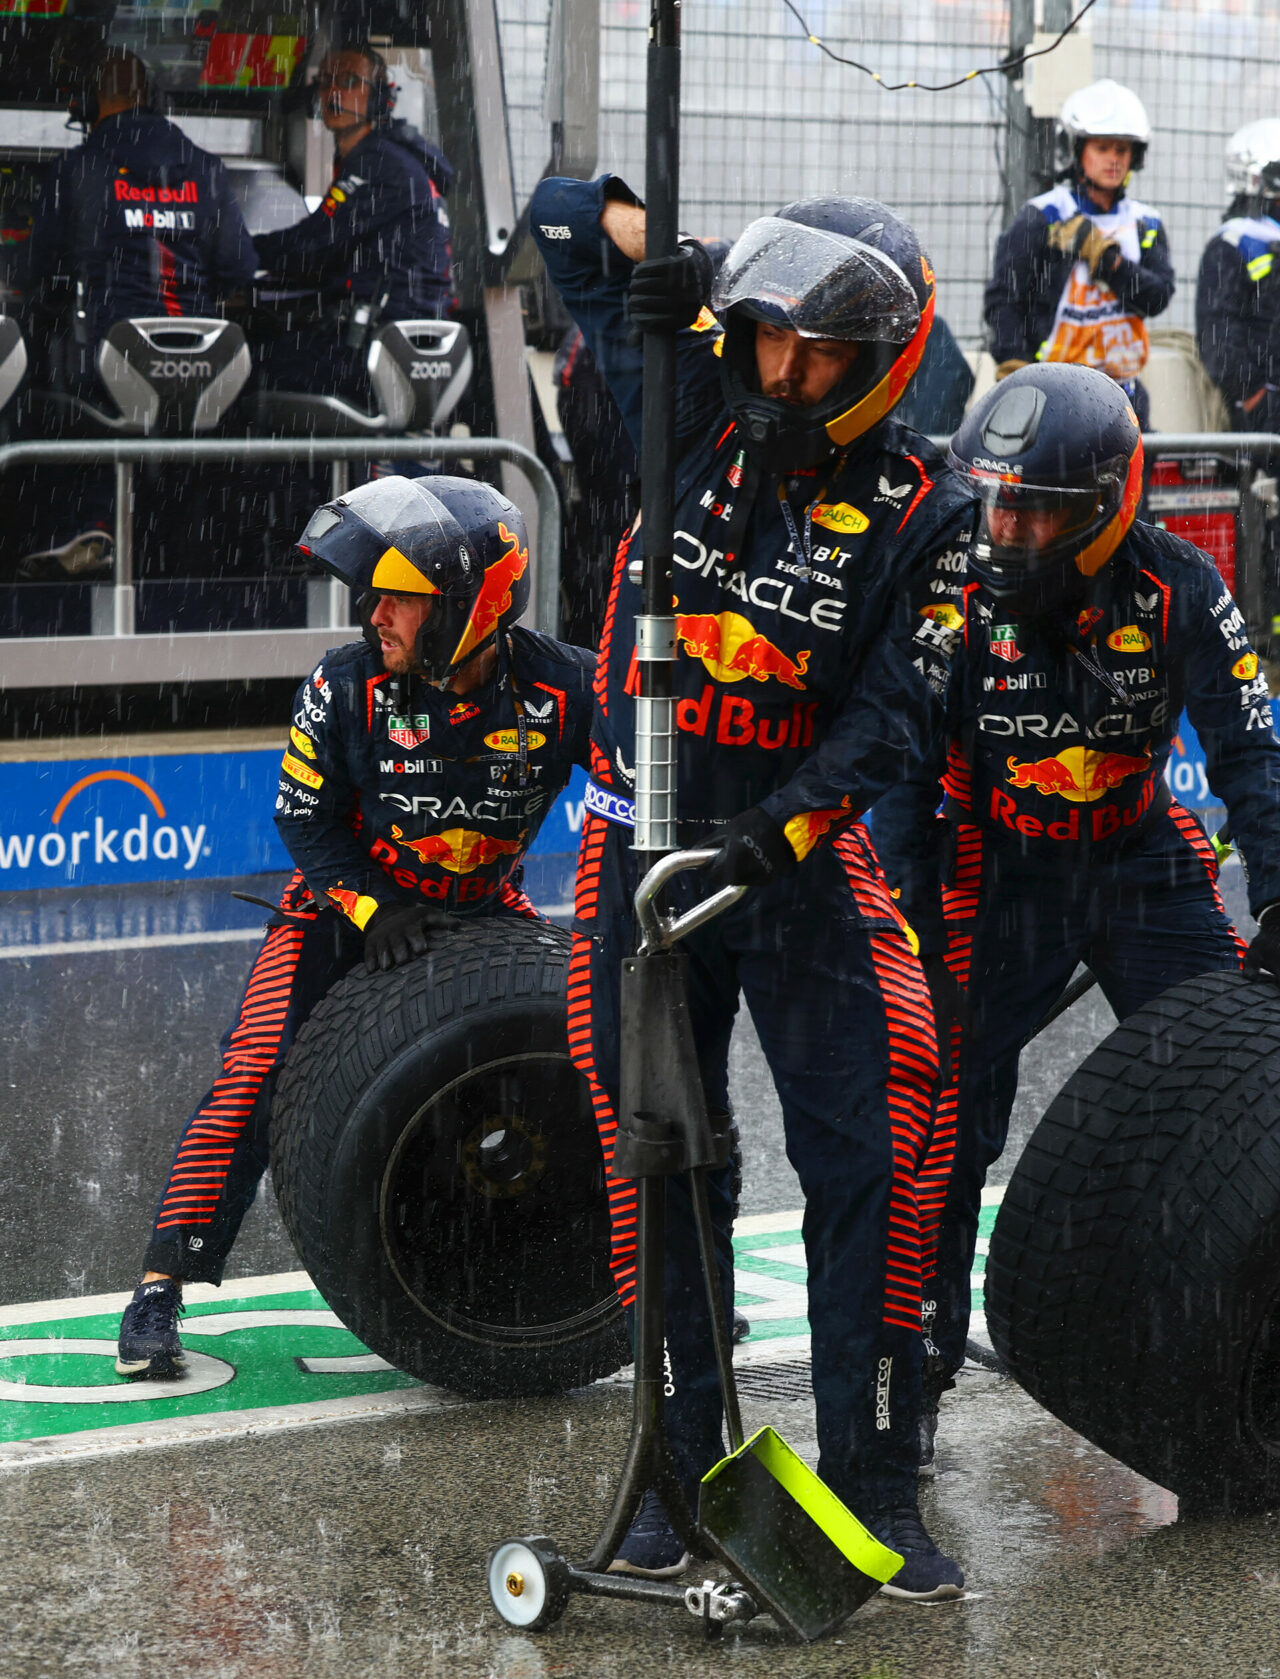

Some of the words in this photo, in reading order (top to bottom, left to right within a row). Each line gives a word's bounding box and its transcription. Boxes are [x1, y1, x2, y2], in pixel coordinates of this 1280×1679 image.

[114, 179, 157, 202] Red
[124, 208, 176, 229] Mobil
[150, 360, 212, 379] zoom
[409, 361, 452, 380] zoom
[821, 508, 862, 530] AUCH
[983, 673, 1028, 692] Mobil
[391, 717, 426, 729] TAG
[716, 694, 821, 750] Bull
[977, 699, 1169, 740] ORACLE
[379, 760, 424, 773] Mobil
[294, 788, 320, 806] App
[989, 786, 1080, 841] Red
[1092, 770, 1159, 841] Bull
[293, 807, 313, 817] poly
[876, 1357, 893, 1430] sparco
